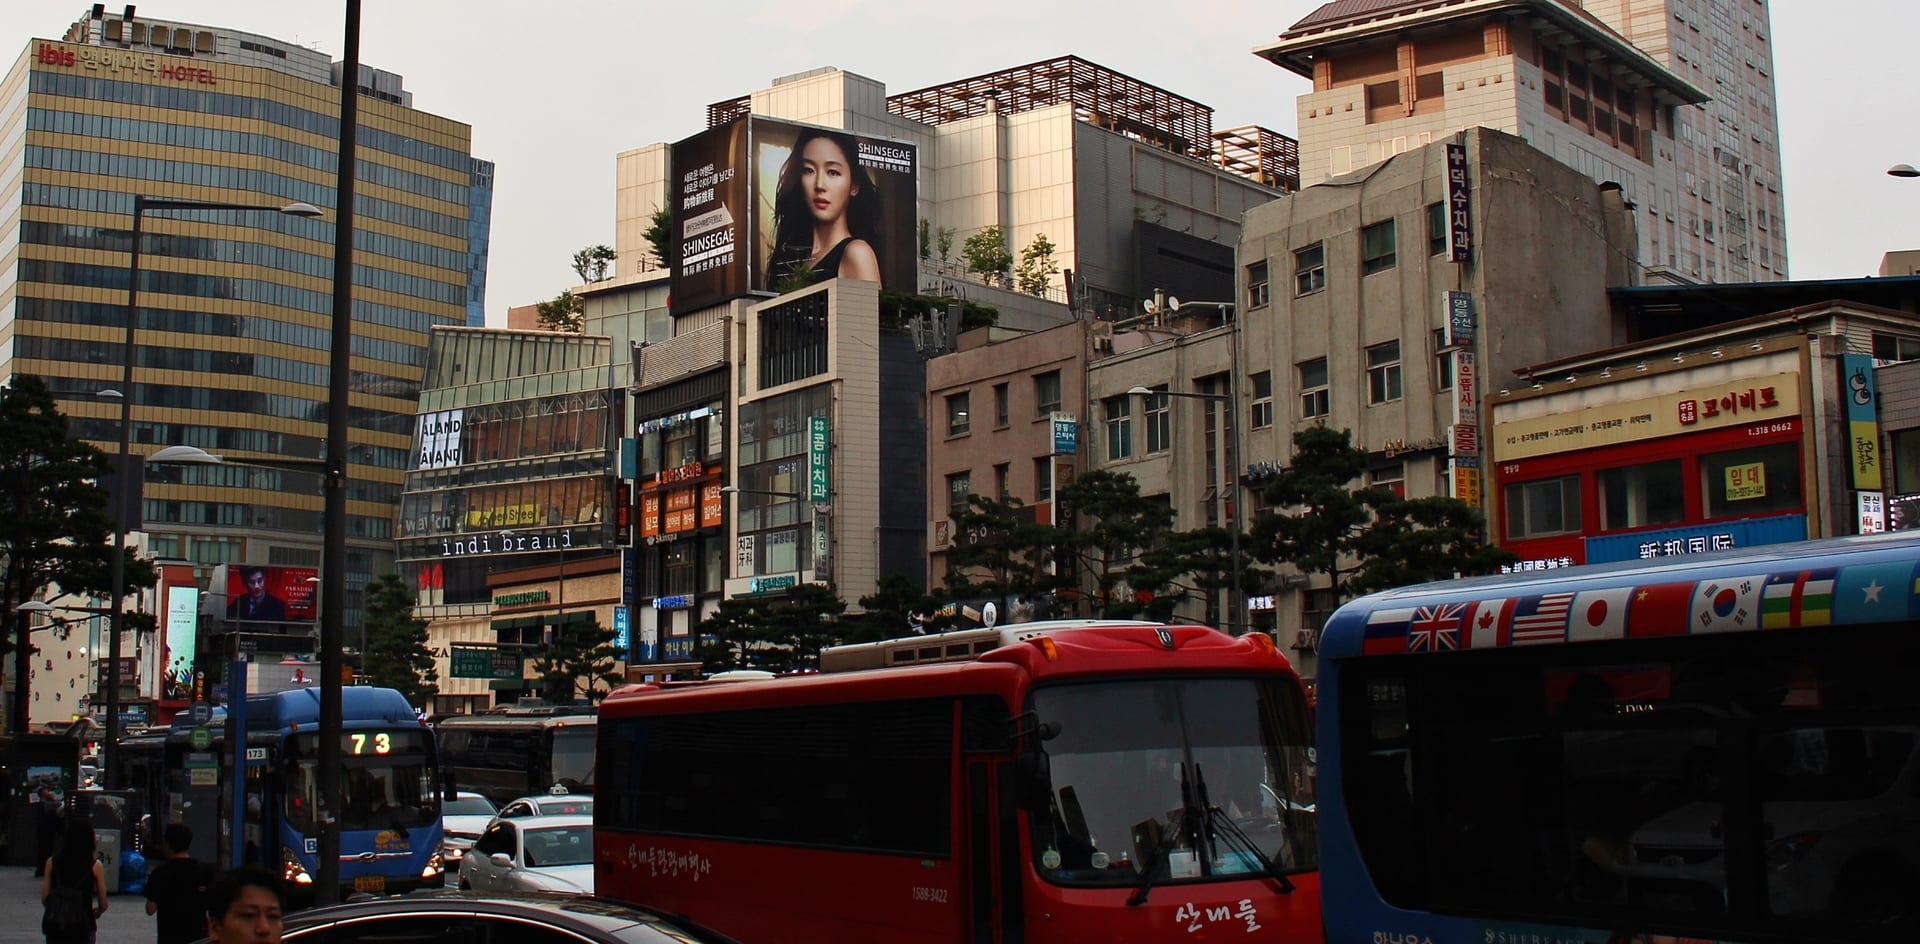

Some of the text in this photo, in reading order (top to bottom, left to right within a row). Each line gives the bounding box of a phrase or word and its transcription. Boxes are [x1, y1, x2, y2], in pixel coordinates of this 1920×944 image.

[39, 43, 76, 68] ibis
[161, 64, 217, 85] HOTEL
[858, 142, 911, 161] SHINSEGAE
[1451, 169, 1468, 250] 덕수치과
[682, 227, 735, 258] SHINSEGAE
[1771, 423, 1792, 434] 0662
[812, 433, 828, 499] 콤비치과
[1731, 466, 1758, 487] 임대
[442, 530, 573, 556] indi brand
[738, 537, 753, 551] 치과
[247, 749, 265, 759] 173
[911, 886, 948, 903] 1588-3422
[1175, 898, 1262, 933] 산내들
